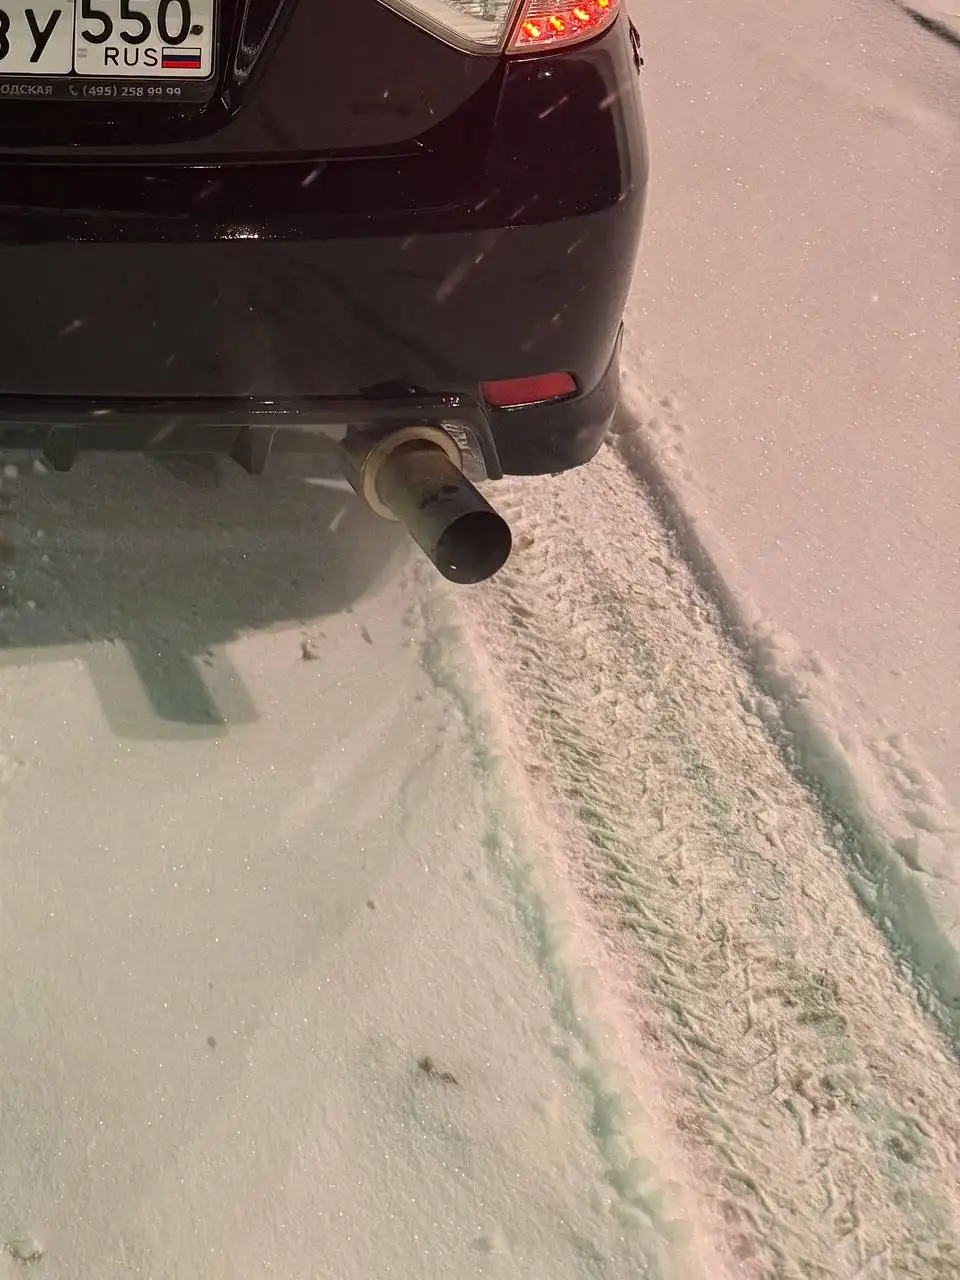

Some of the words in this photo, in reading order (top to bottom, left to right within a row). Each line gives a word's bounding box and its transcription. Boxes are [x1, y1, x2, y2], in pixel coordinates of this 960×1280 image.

[104, 47, 159, 68] RUS
[83, 85, 117, 97] (495)
[121, 86, 144, 96] 258
[147, 87, 163, 96] 99
[166, 87, 182, 97] 99
